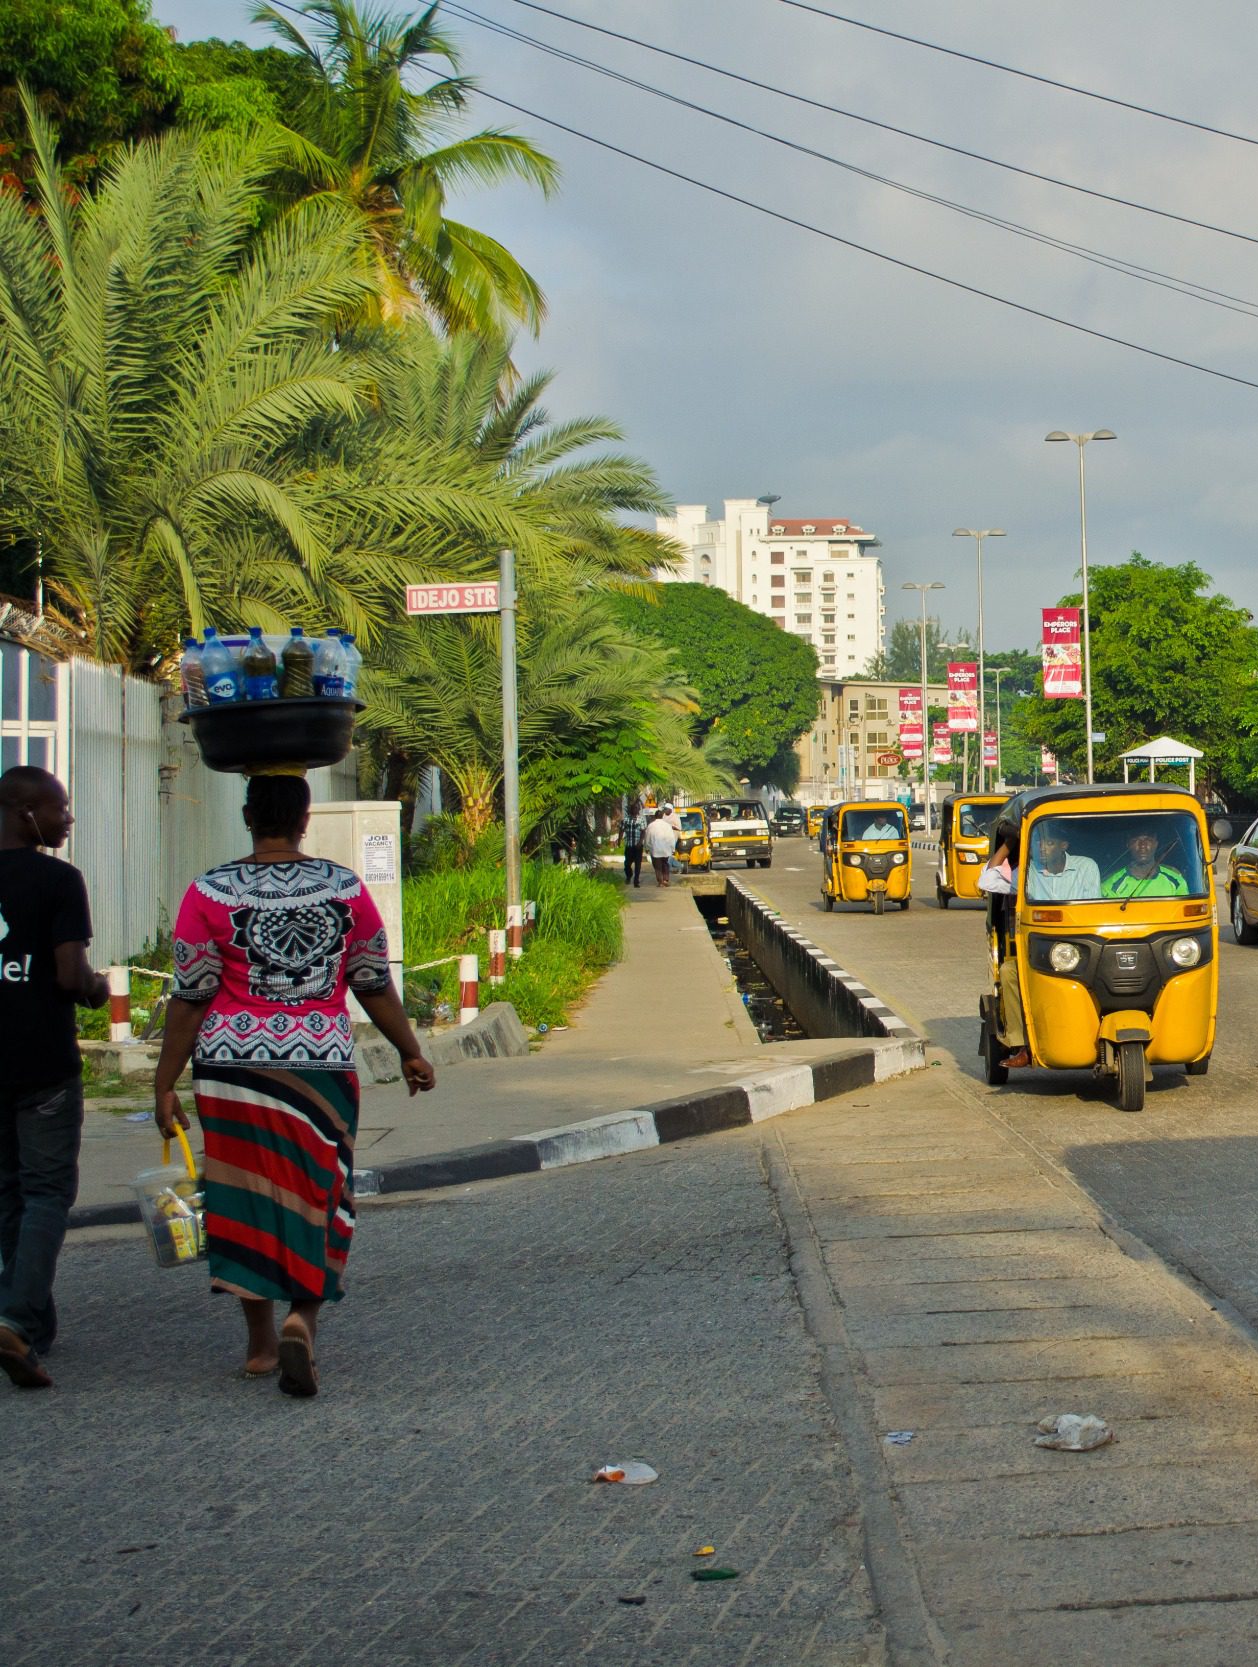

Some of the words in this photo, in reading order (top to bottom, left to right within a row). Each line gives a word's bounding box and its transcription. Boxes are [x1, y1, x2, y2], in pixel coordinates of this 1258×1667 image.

[412, 590, 460, 608] IDEJO
[464, 588, 496, 606] STR
[214, 684, 233, 693] eva
